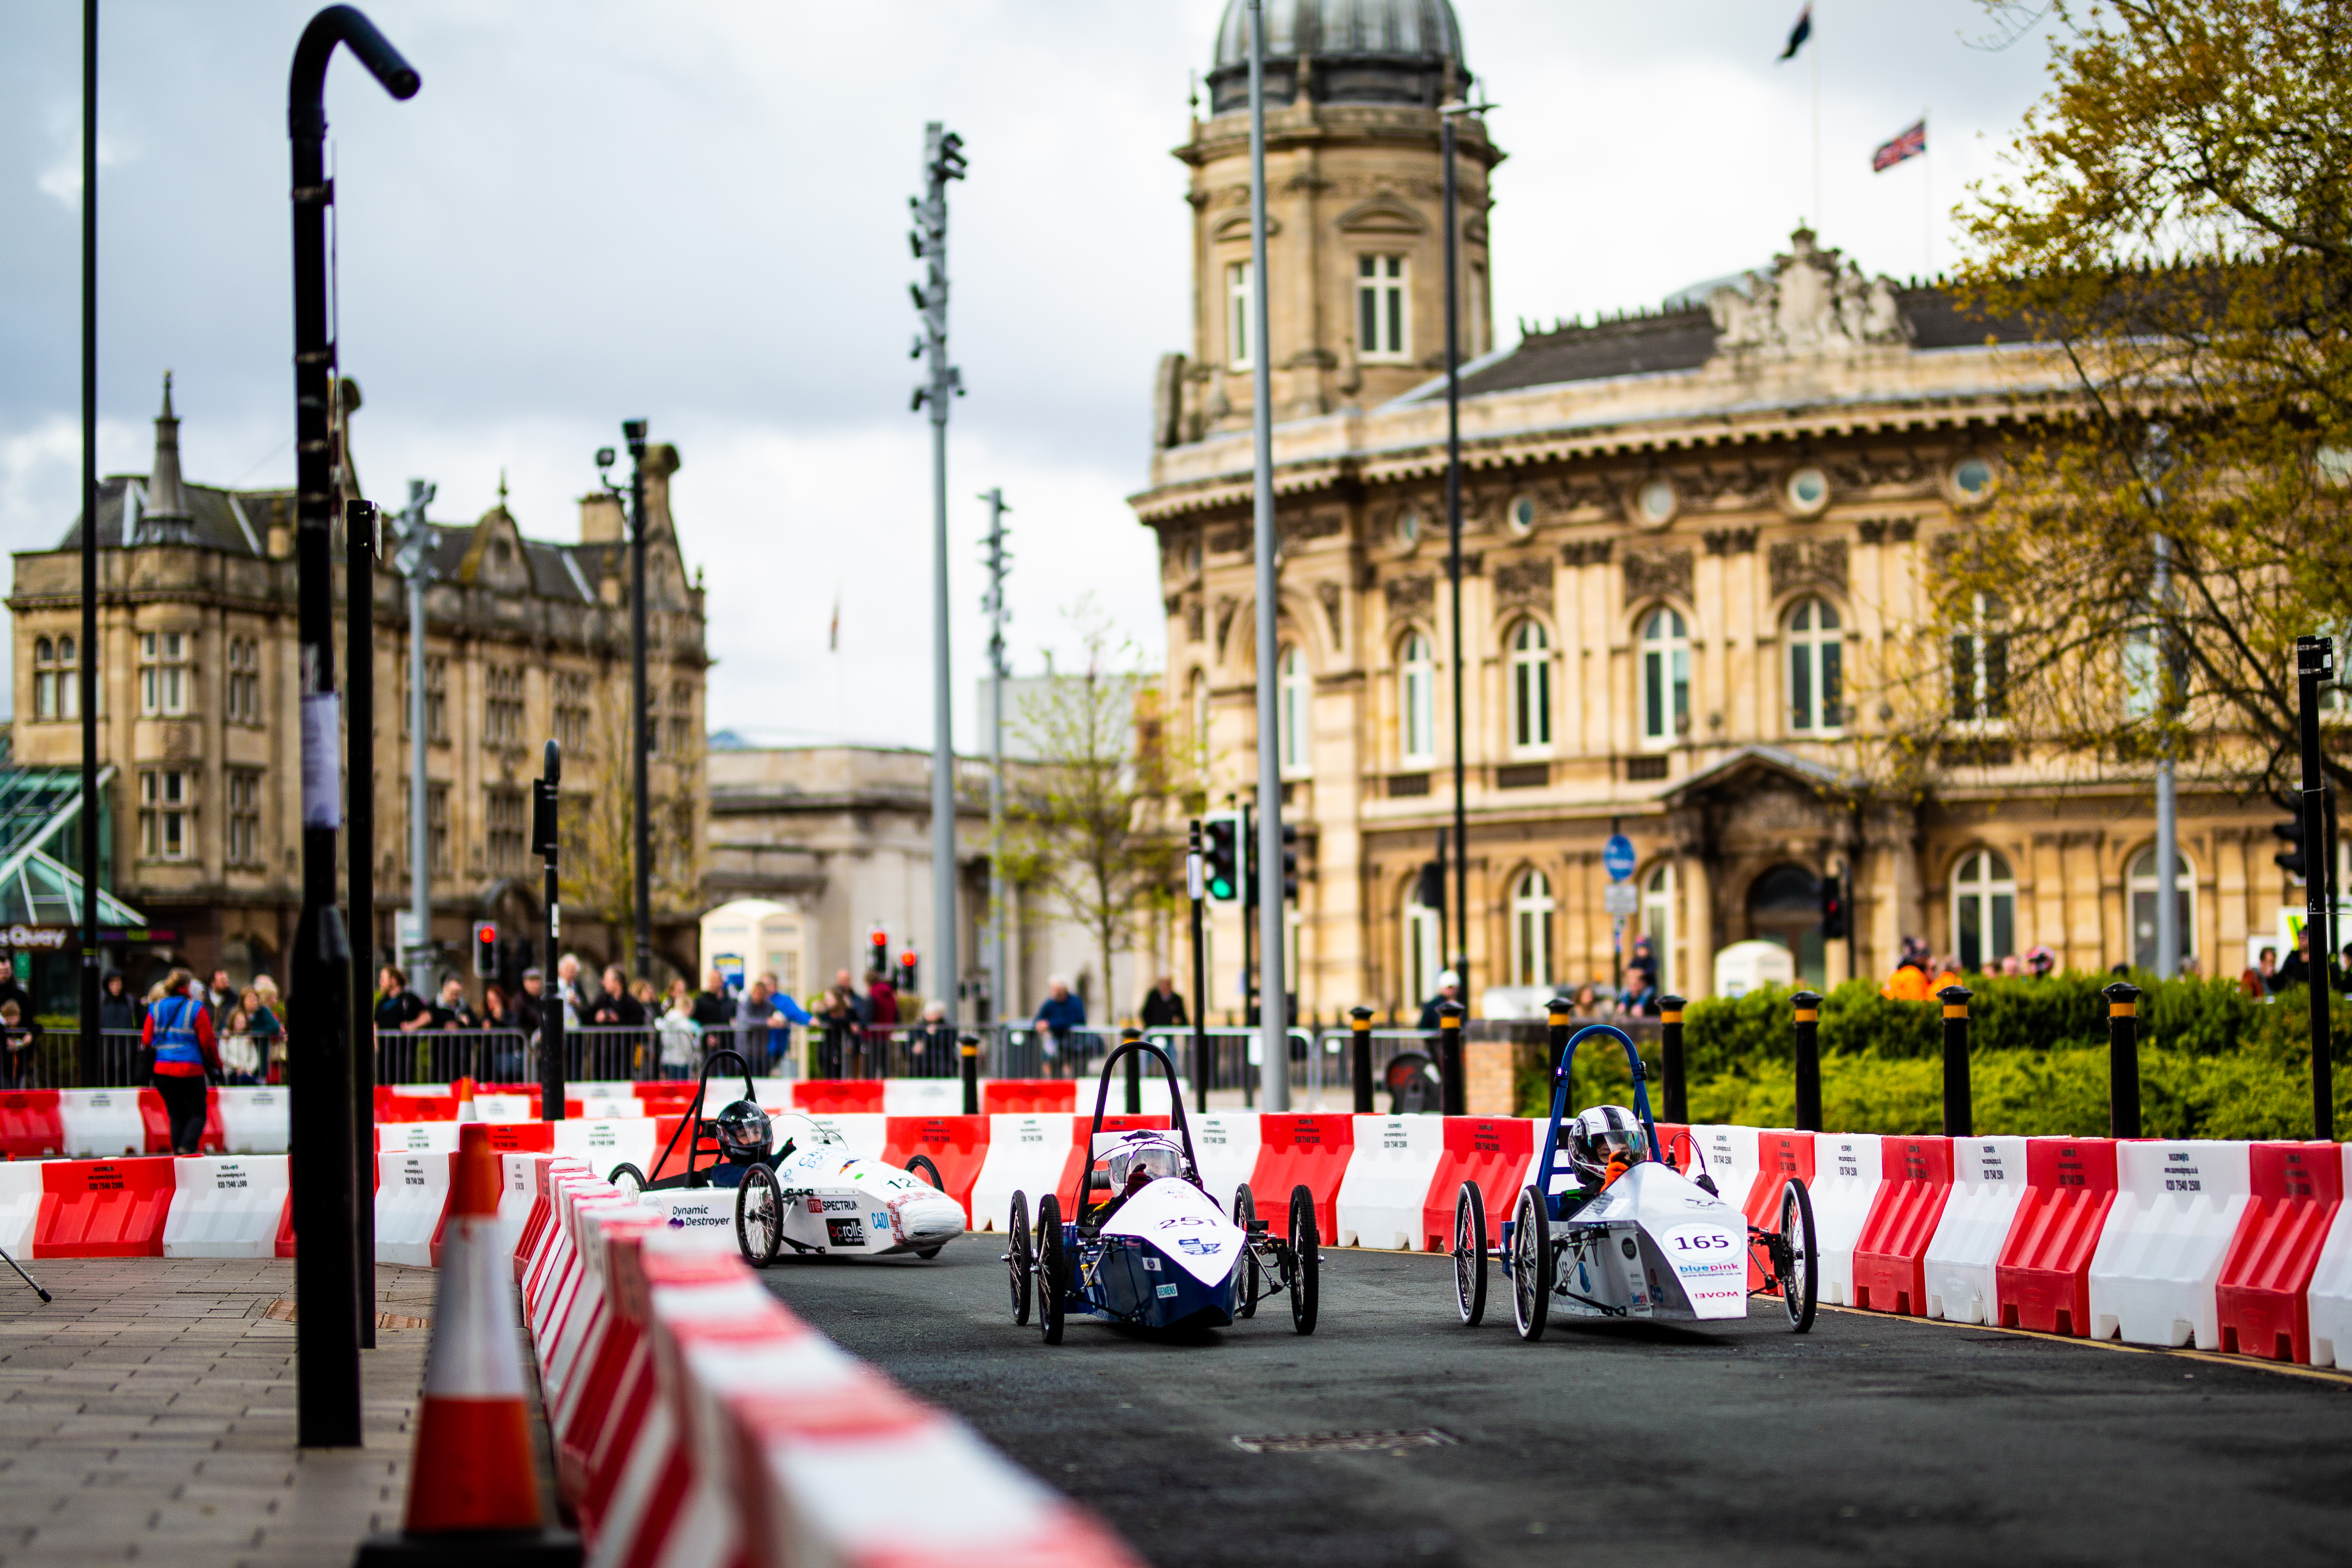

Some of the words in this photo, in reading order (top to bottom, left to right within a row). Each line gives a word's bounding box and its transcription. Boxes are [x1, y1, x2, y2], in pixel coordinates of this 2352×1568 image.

[10, 925, 66, 949] Quay
[886, 1178, 928, 1189] 129
[2166, 1180, 2175, 1190] 020
[2175, 1180, 2187, 1191] 7540
[2188, 1180, 2201, 1191] 2500
[673, 1205, 708, 1217] Dynamic
[686, 1217, 730, 1227] Destroyer
[871, 1212, 889, 1229] C4DI
[1159, 1217, 1217, 1229] 251
[1675, 1235, 1728, 1250] 165
[1680, 1264, 1739, 1272] bluepink
[1158, 1285, 1176, 1296] SIEMENS
